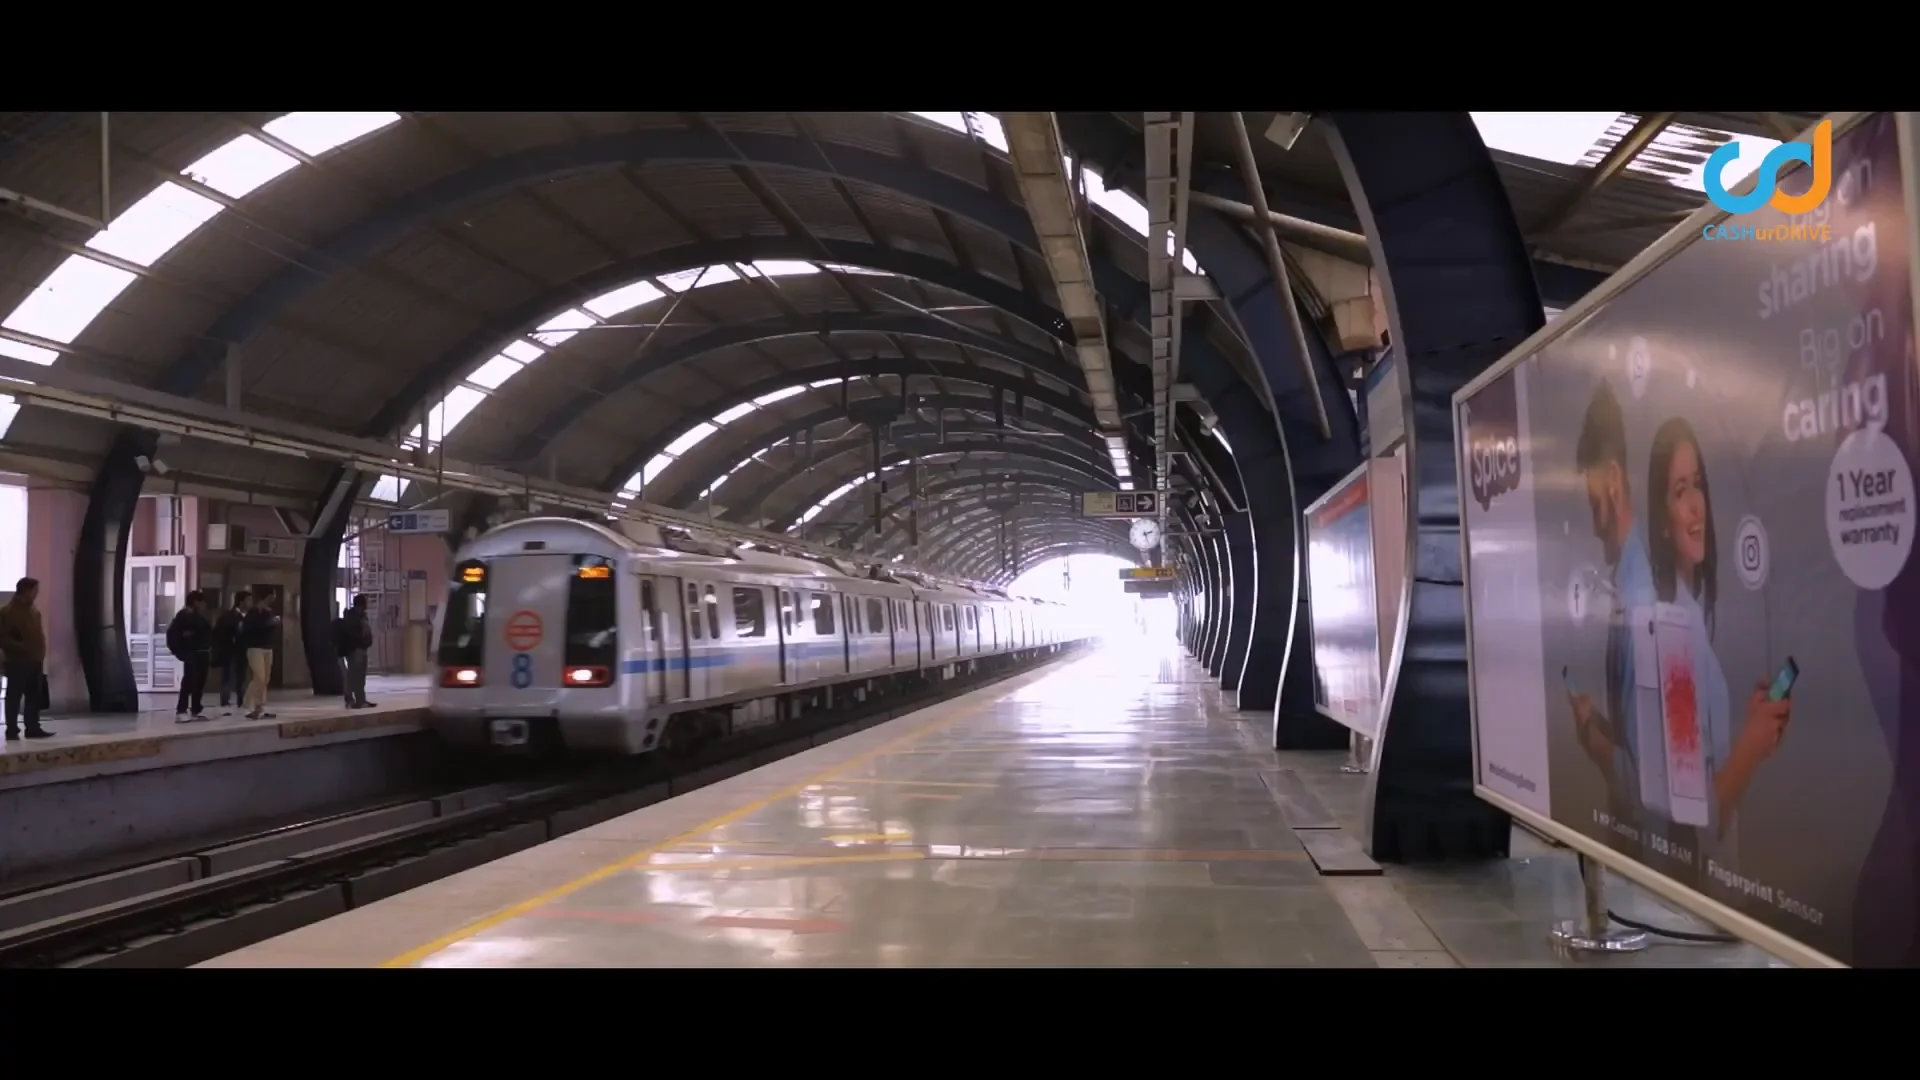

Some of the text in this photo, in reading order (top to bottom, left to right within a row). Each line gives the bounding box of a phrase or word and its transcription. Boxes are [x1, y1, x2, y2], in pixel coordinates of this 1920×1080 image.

[1758, 221, 1878, 320] sharing
[1799, 308, 1885, 372] Big on
[1783, 372, 1888, 442] caring
[1836, 468, 1896, 502] 1 Year
[1841, 521, 1900, 546] warranty
[510, 653, 533, 690] 8
[1707, 859, 1824, 925] Fingerprint Sensor
